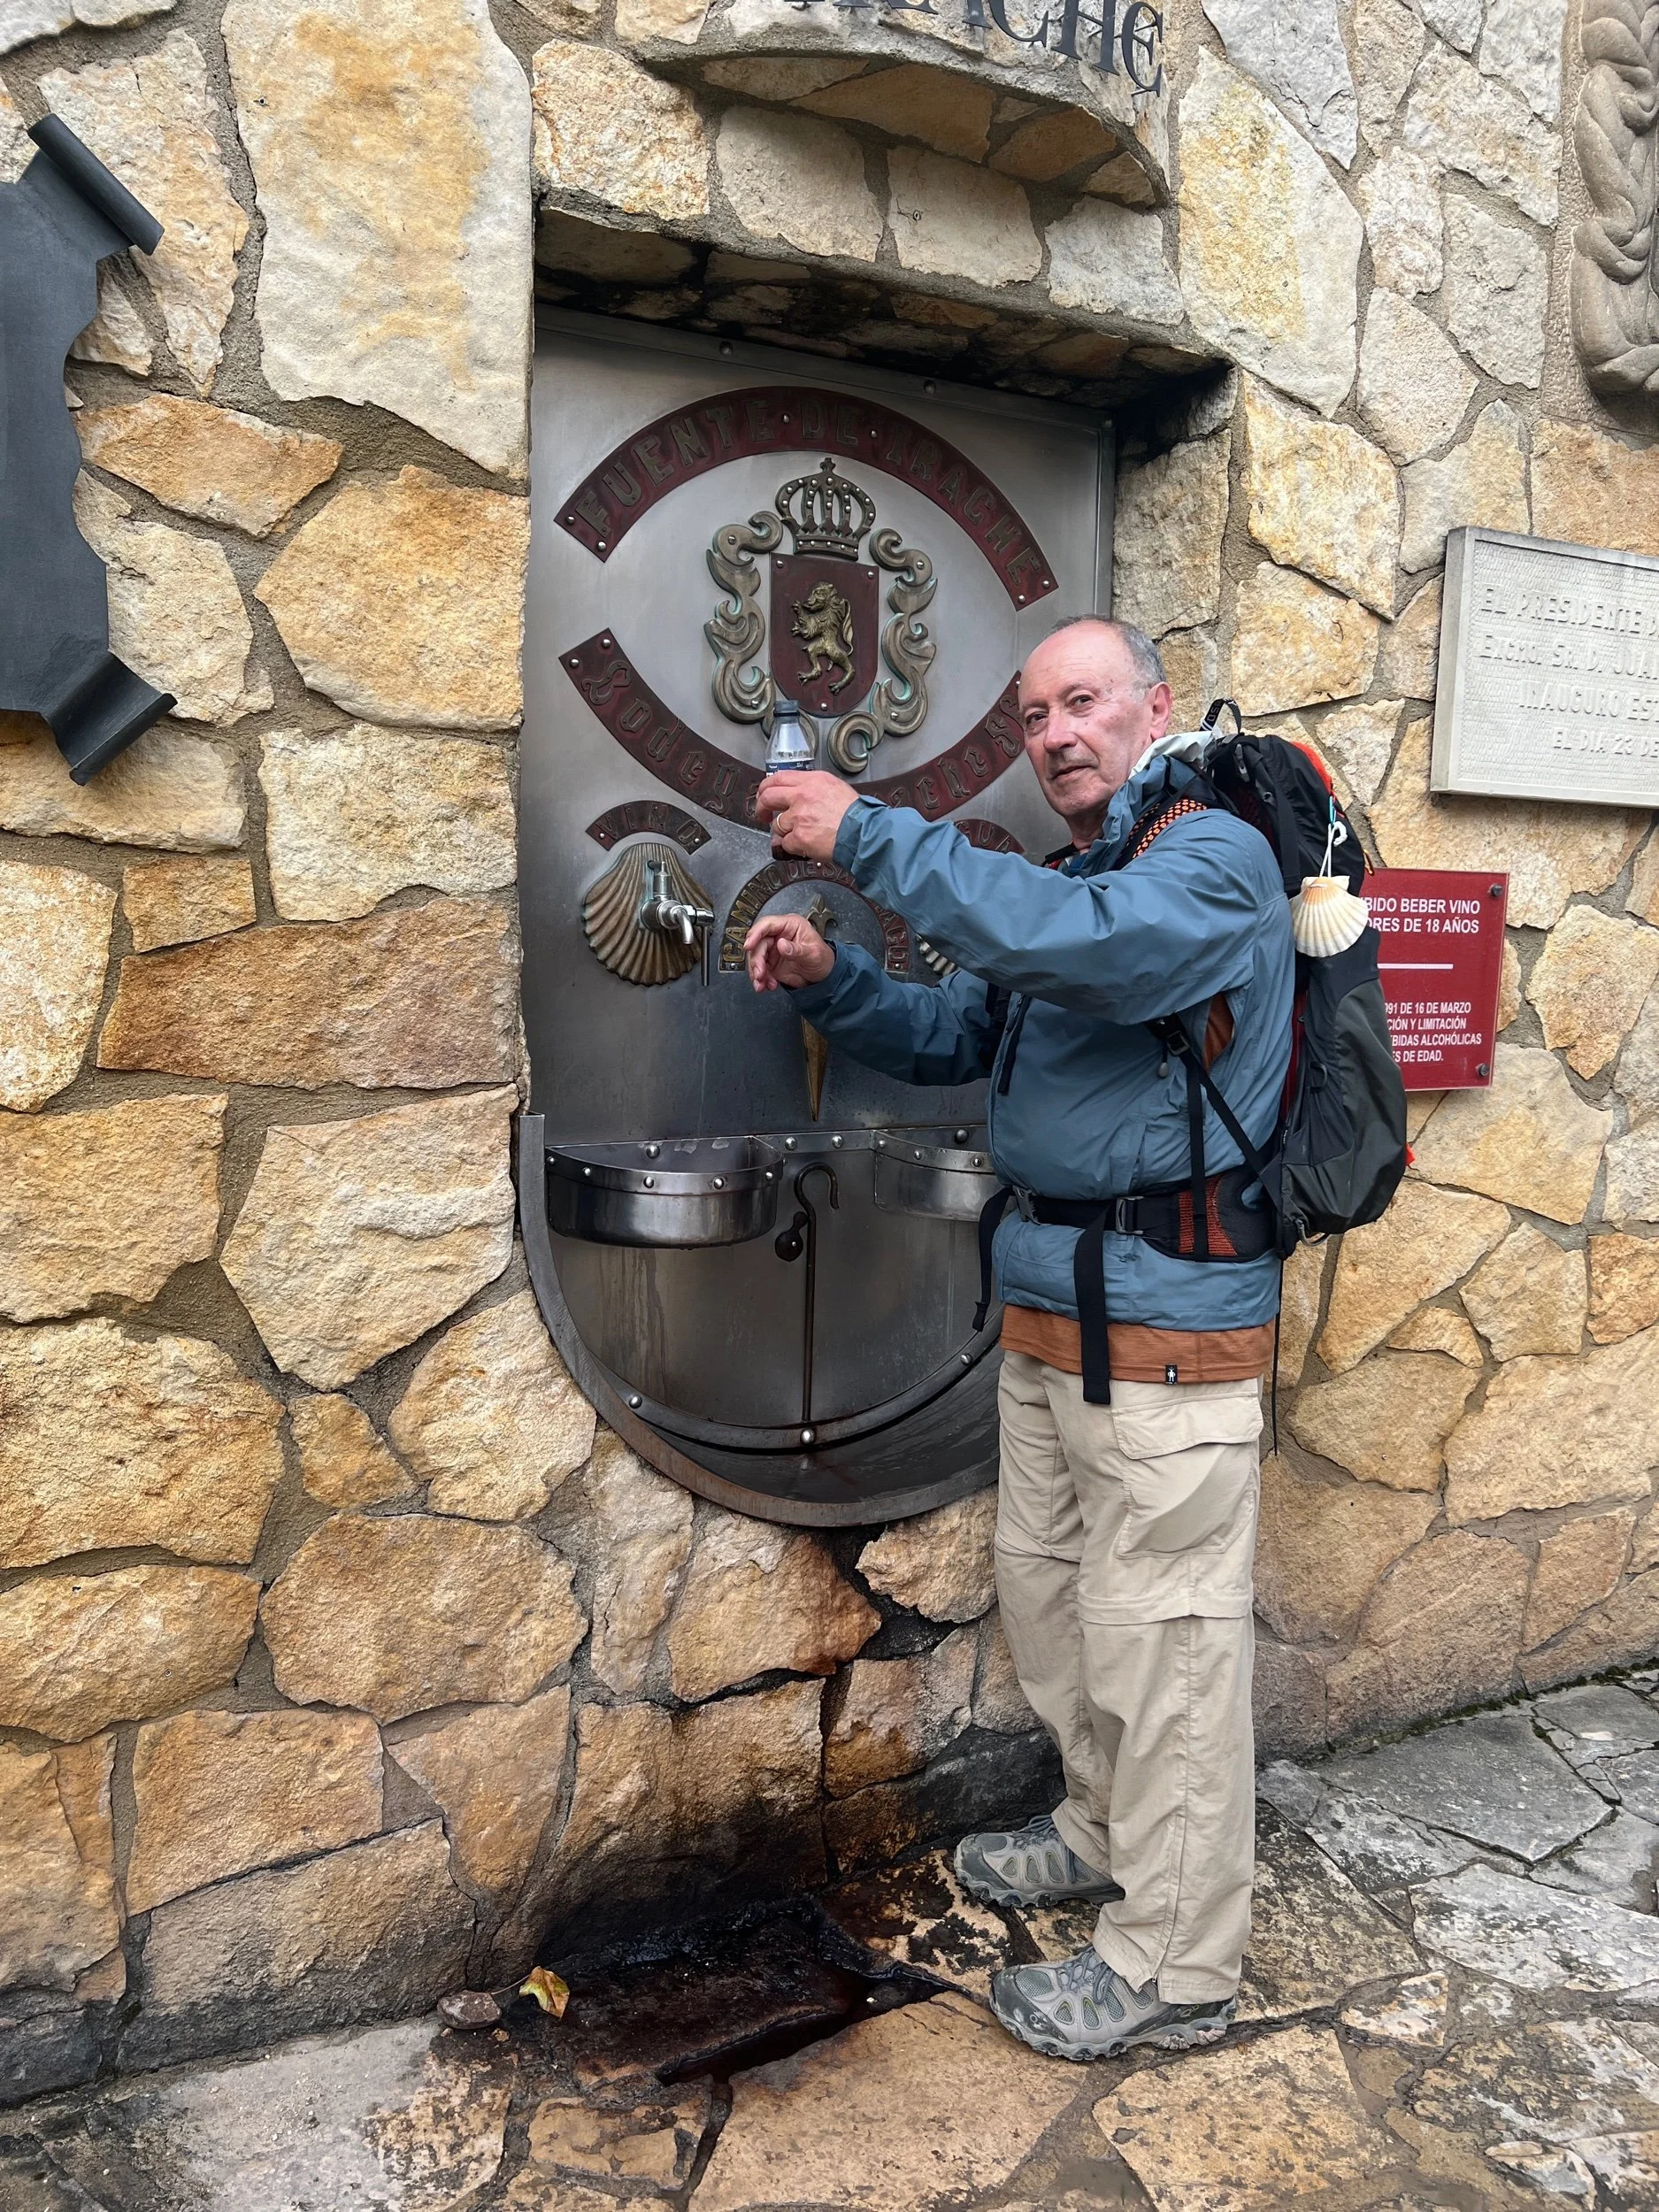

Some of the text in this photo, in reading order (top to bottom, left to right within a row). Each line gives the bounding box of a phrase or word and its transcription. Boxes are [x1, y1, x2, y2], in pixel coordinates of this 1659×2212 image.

[575, 399, 1042, 587] FUENTE DE IRACHE
[595, 804, 703, 846] VINO
[723, 863, 783, 963] CAMINO
[1363, 897, 1480, 915] BIDO BEBER VINO
[1403, 918, 1422, 933] DE
[1425, 918, 1440, 933] 18
[1442, 917, 1479, 933] AÑOS
[1401, 1002, 1413, 1014] DE
[1415, 1002, 1425, 1014] 16
[1426, 1002, 1439, 1014] DE
[1440, 1002, 1471, 1014] MARZO
[1386, 1015, 1467, 1031] CIÓN Y LIMITACIÓN
[1391, 1032, 1482, 1046] BIDAS ALCOHÓLICAS
[1403, 1050, 1415, 1062] DE
[1417, 1049, 1444, 1062] EDAD.
